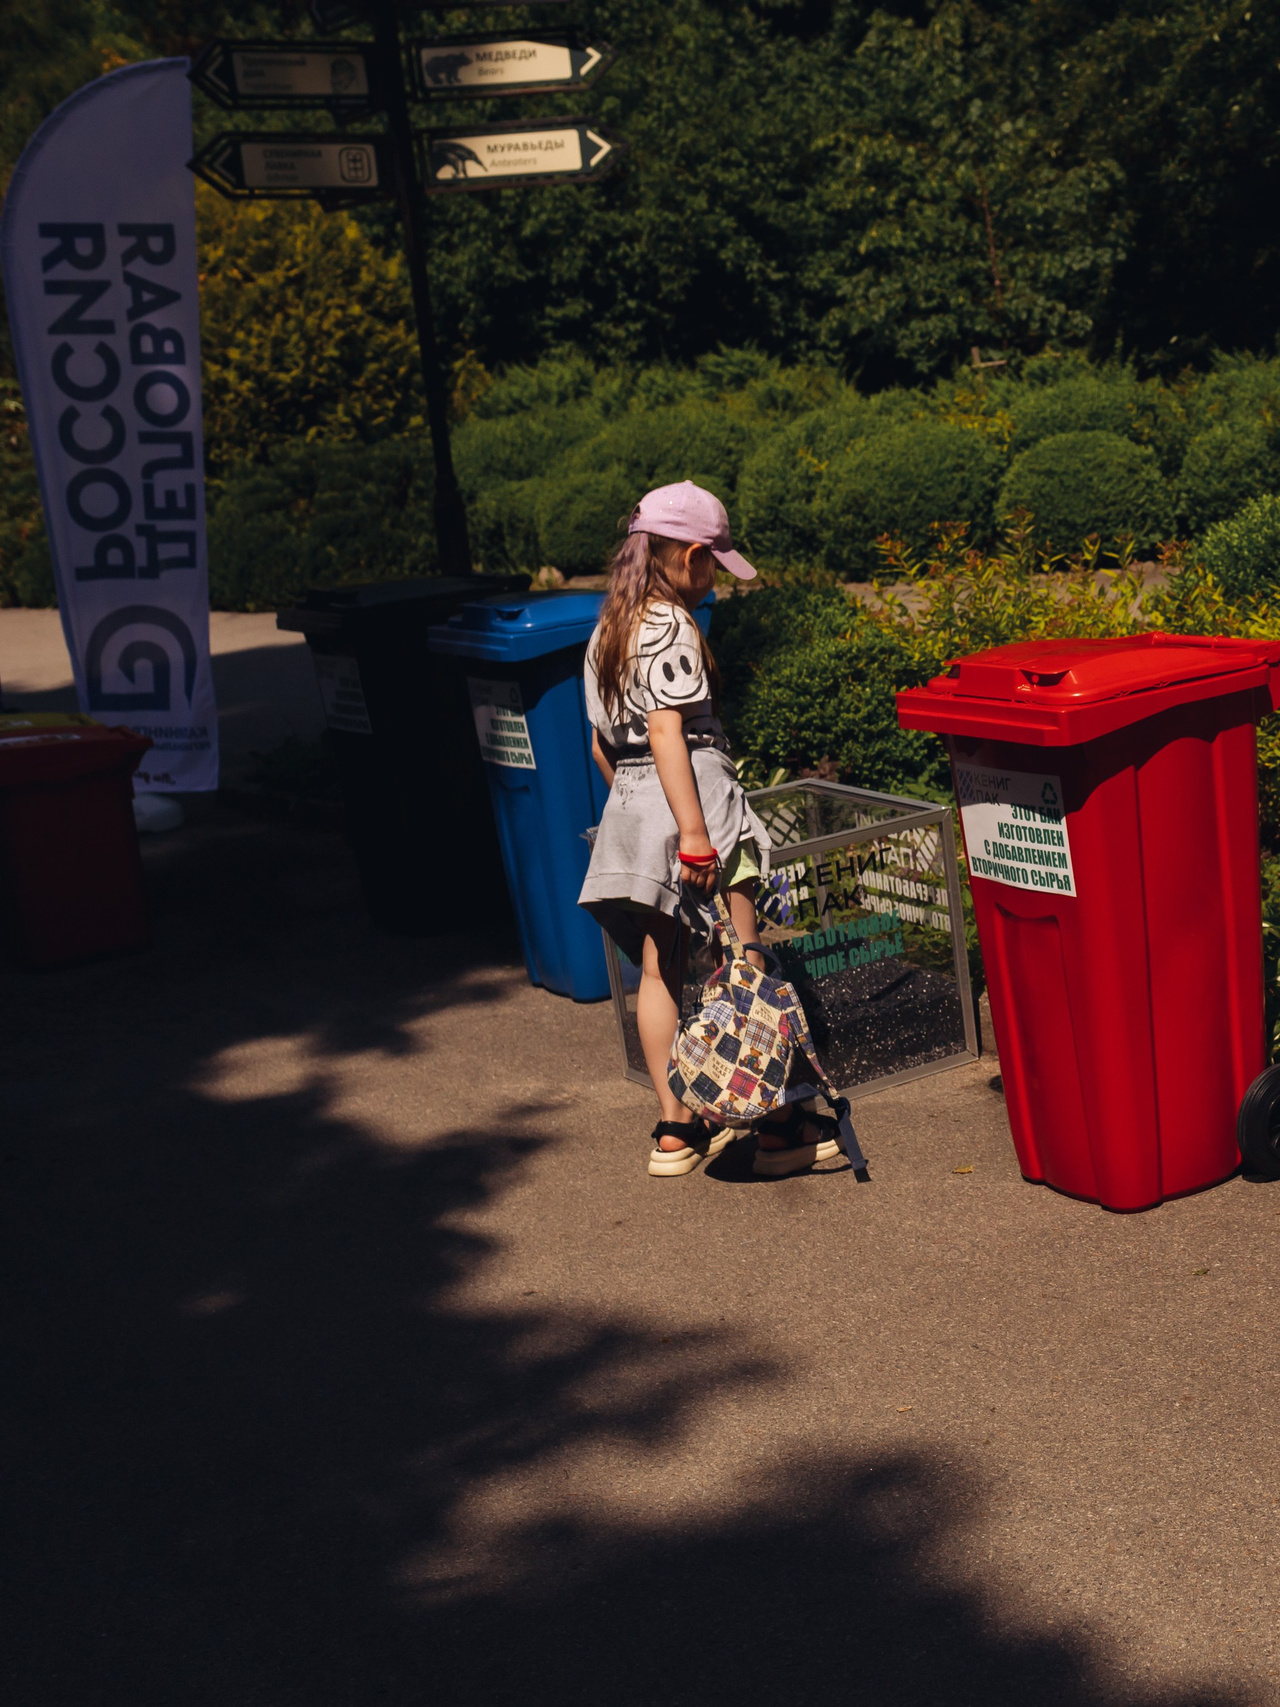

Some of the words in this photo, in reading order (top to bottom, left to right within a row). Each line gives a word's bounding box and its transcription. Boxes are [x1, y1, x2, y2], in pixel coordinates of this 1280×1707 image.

[475, 49, 537, 62] МЕДВЕДИ
[478, 66, 504, 76] Bears
[487, 139, 565, 154] МУРАВЬЕДЫ
[974, 773, 1011, 790] КЕНИГ
[976, 790, 1000, 806] ПАК
[1011, 803, 1038, 822] ЭТОТ
[1040, 807, 1062, 825] БАК
[998, 822, 1064, 847] ИЗГОТОВЛЕН
[984, 839, 991, 856] С
[992, 841, 1068, 869] ДОБАВЛЕНИЕМ
[795, 847, 892, 892] КЕНИГ
[971, 856, 1028, 884] ВТОРИЧНОГО
[1031, 869, 1071, 891] СЫРЬЯ
[798, 885, 863, 922] ПАК
